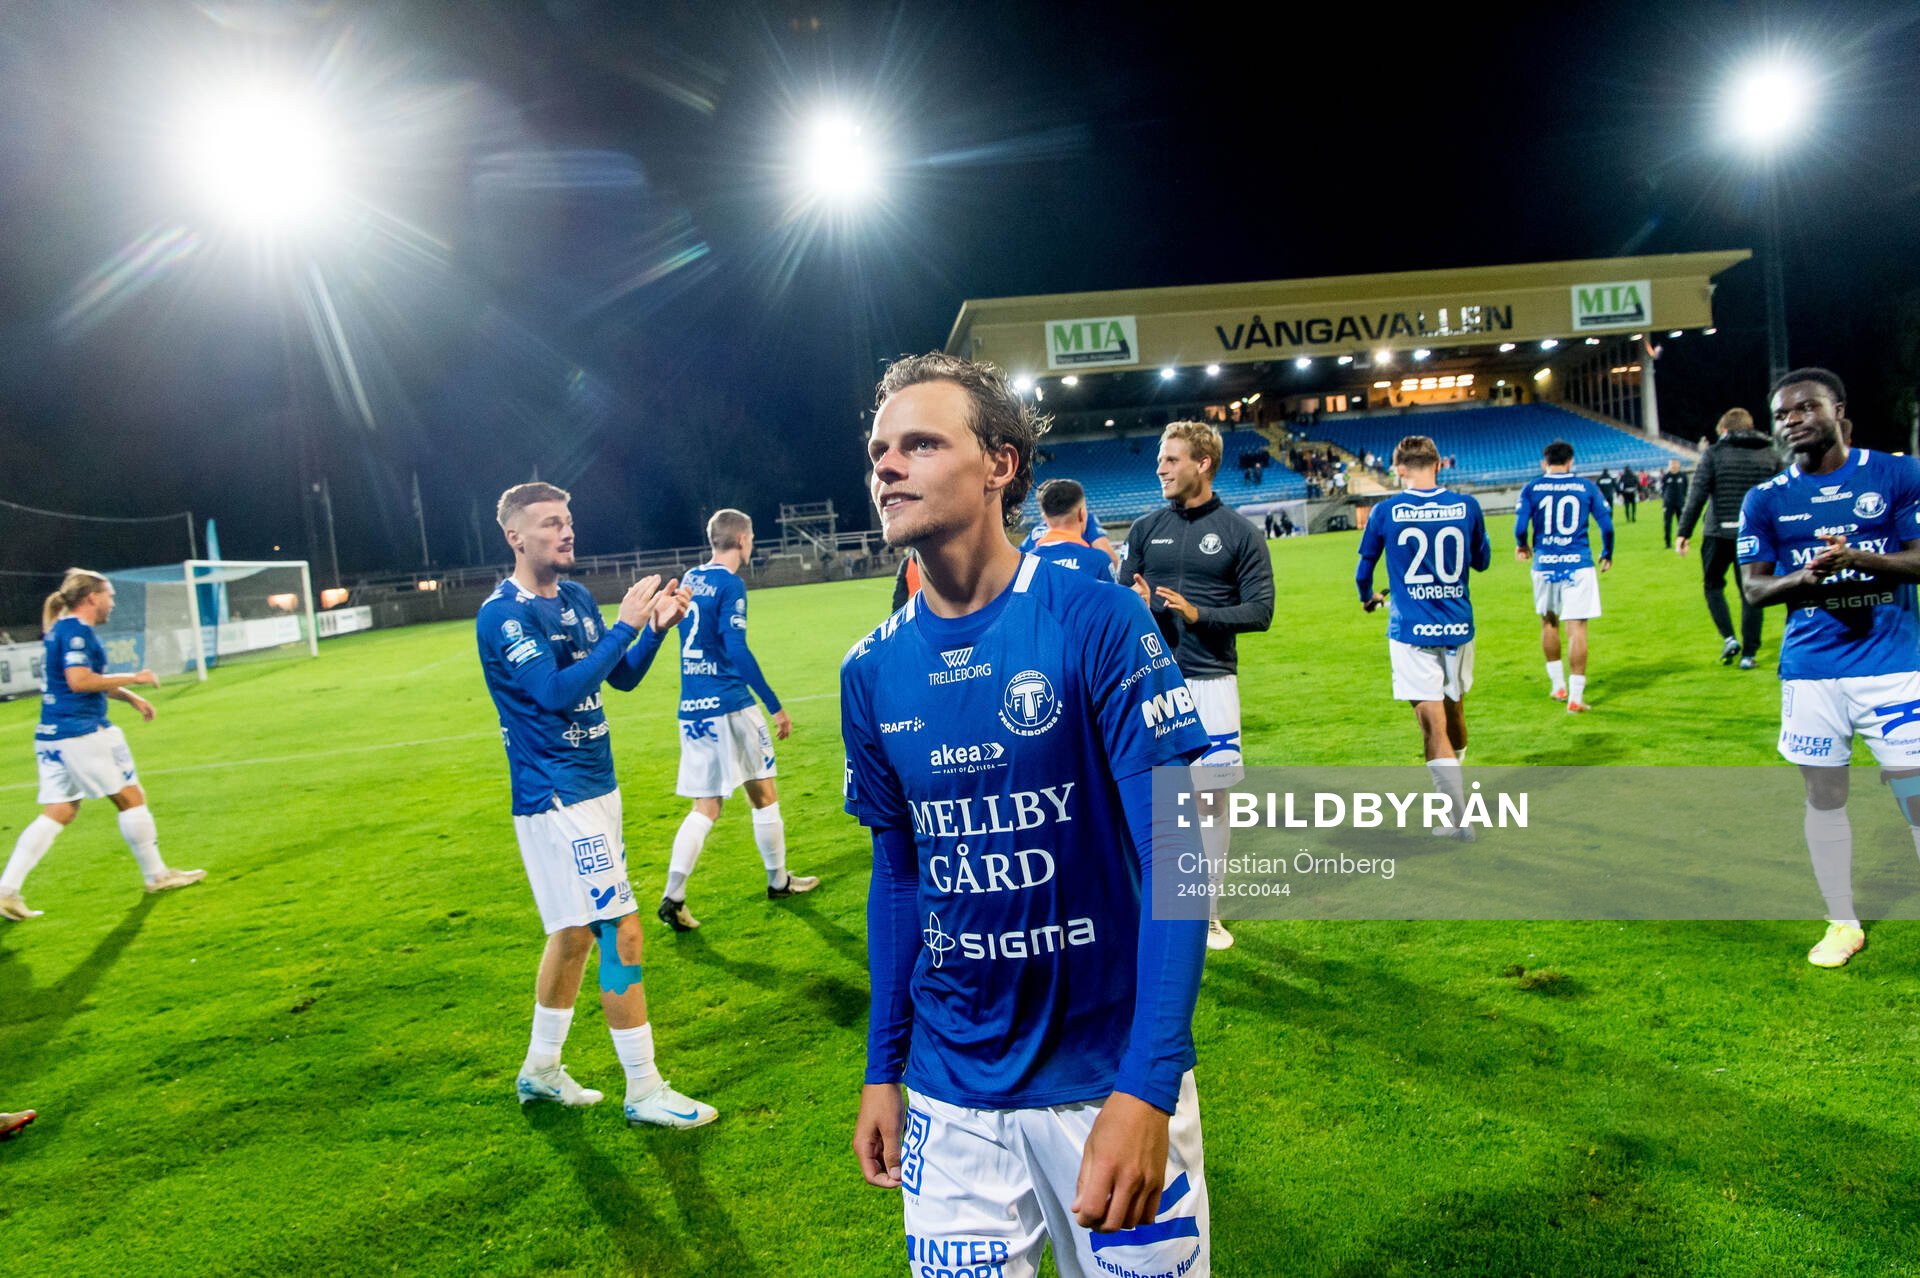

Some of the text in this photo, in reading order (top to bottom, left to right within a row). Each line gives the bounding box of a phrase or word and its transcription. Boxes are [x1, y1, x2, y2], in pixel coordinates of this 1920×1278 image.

[1579, 286, 1643, 314] MTA
[1053, 320, 1129, 353] MTA
[1215, 305, 1514, 351] VÅNGAVALLEN
[1538, 495, 1580, 535] 10
[1397, 526, 1464, 584] 20
[928, 663, 992, 686] TRELLEBORG
[998, 709, 1058, 736] TRELLEBORGS
[1141, 686, 1195, 728] MVB
[880, 720, 913, 733] CRAFT
[930, 744, 982, 766] akea
[908, 782, 1075, 837] MELLBY
[929, 843, 1056, 894] GÅRD
[919, 1237, 1009, 1267] INTER
[1176, 1244, 1201, 1277] Hamn
